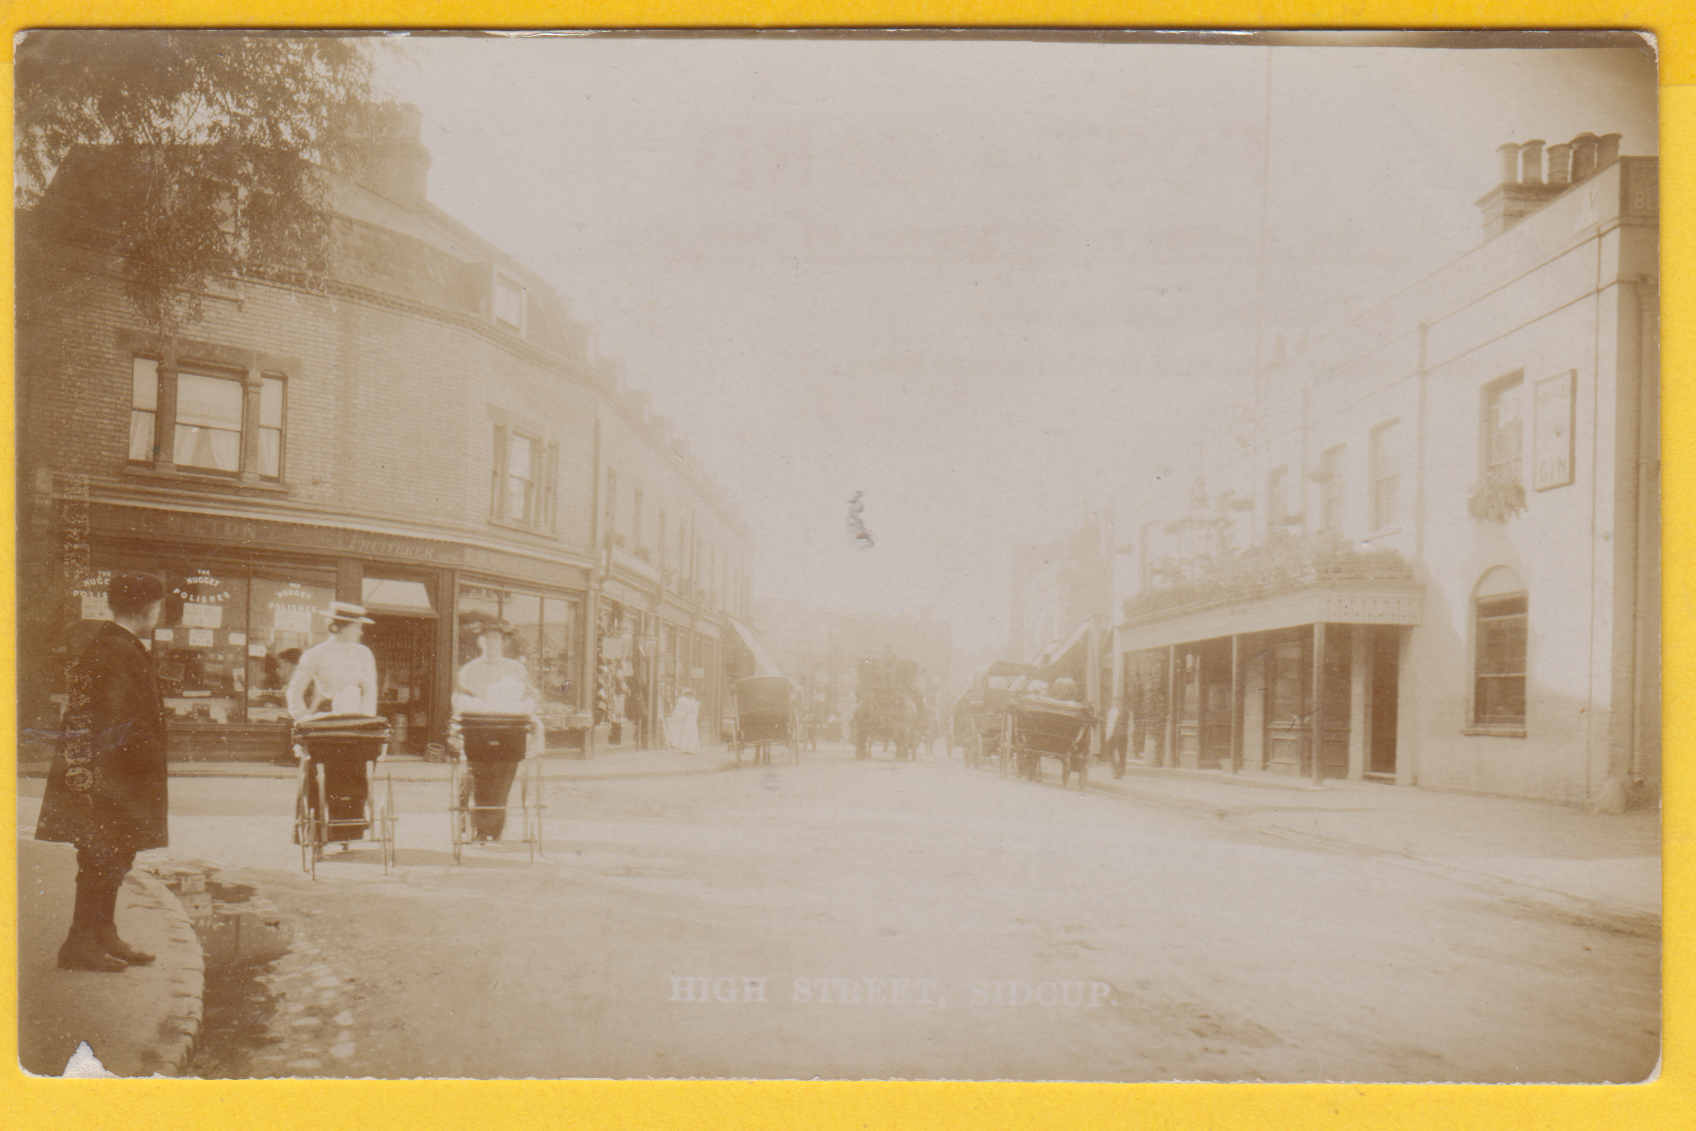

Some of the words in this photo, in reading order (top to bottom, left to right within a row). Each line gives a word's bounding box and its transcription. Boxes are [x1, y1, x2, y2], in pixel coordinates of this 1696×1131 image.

[1538, 454, 1567, 482] GIN
[167, 516, 256, 541] MILTON
[348, 534, 436, 560] FRUITERER
[83, 577, 111, 588] NUGG
[186, 576, 222, 588] NUGGET
[73, 590, 108, 599] POLIS
[172, 587, 231, 603] POLISHES
[276, 588, 313, 600] NUGGET
[268, 602, 317, 613] POLISHES
